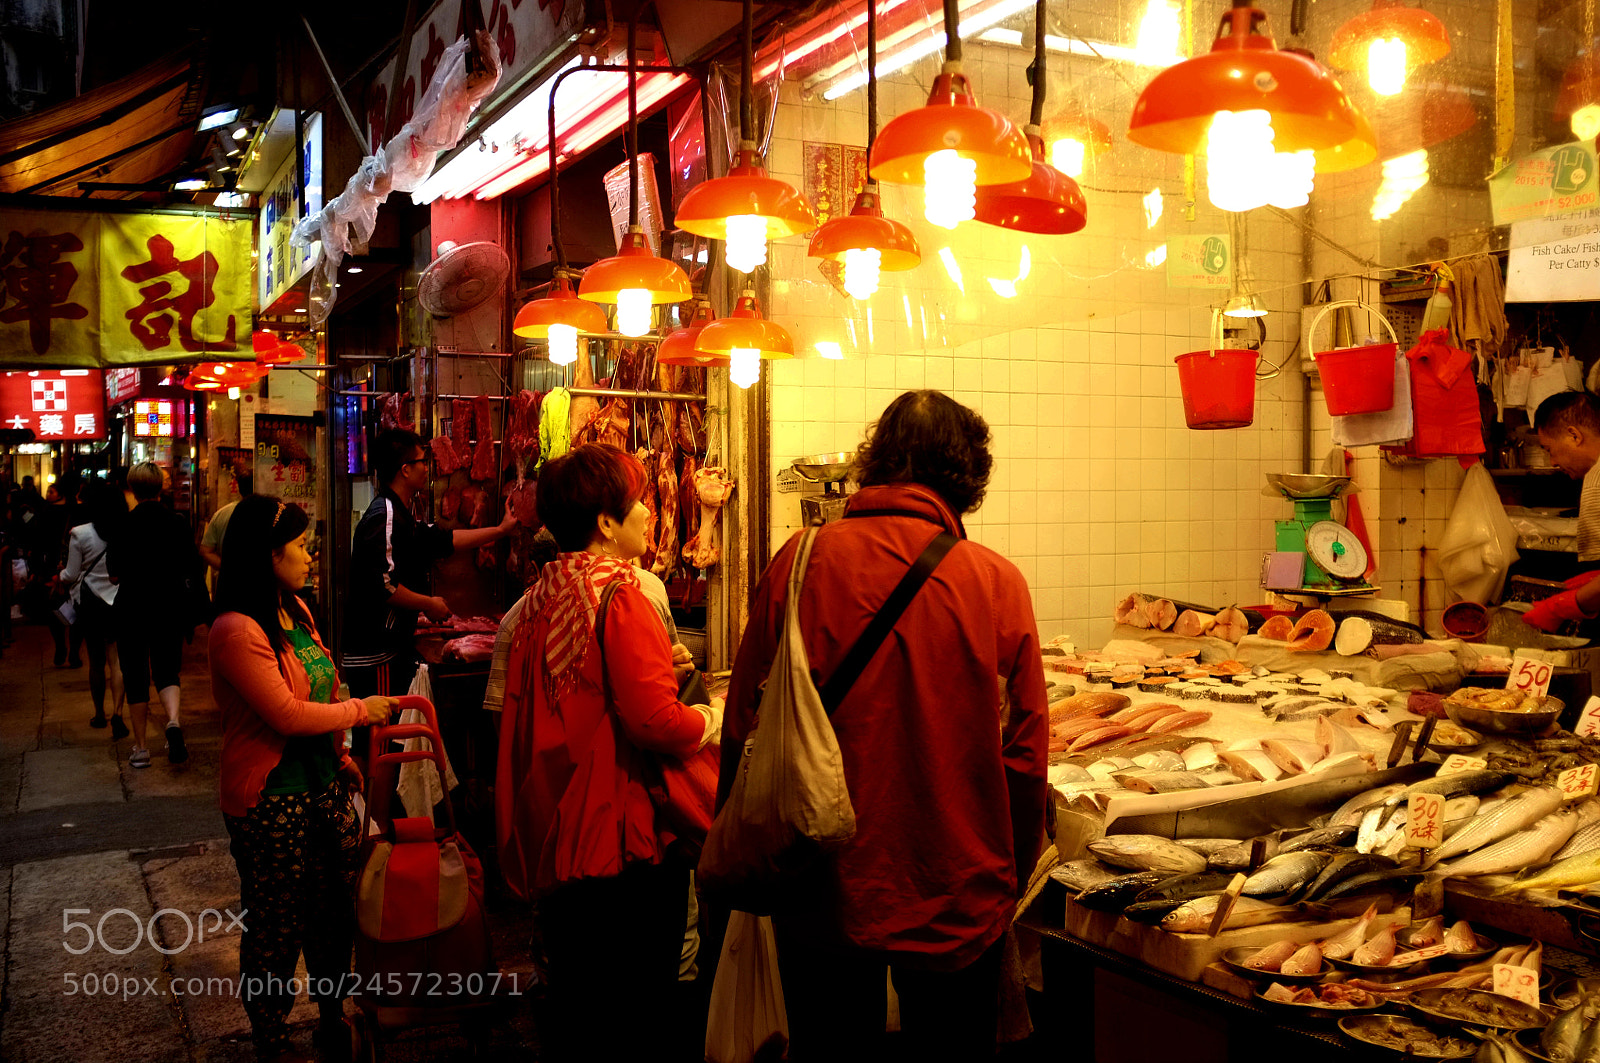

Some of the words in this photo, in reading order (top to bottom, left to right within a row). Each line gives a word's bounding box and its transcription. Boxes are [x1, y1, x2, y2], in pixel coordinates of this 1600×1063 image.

[1558, 192, 1595, 208] $2,000
[1532, 245, 1551, 256] Fish
[1553, 243, 1580, 255] Cake/
[1582, 242, 1600, 253] Fish
[1549, 259, 1563, 270] Per
[1566, 258, 1591, 270] Catty
[5, 413, 96, 436] 大藥房
[1516, 660, 1550, 689] 50
[1562, 766, 1593, 785] 35
[1413, 796, 1439, 822] 30
